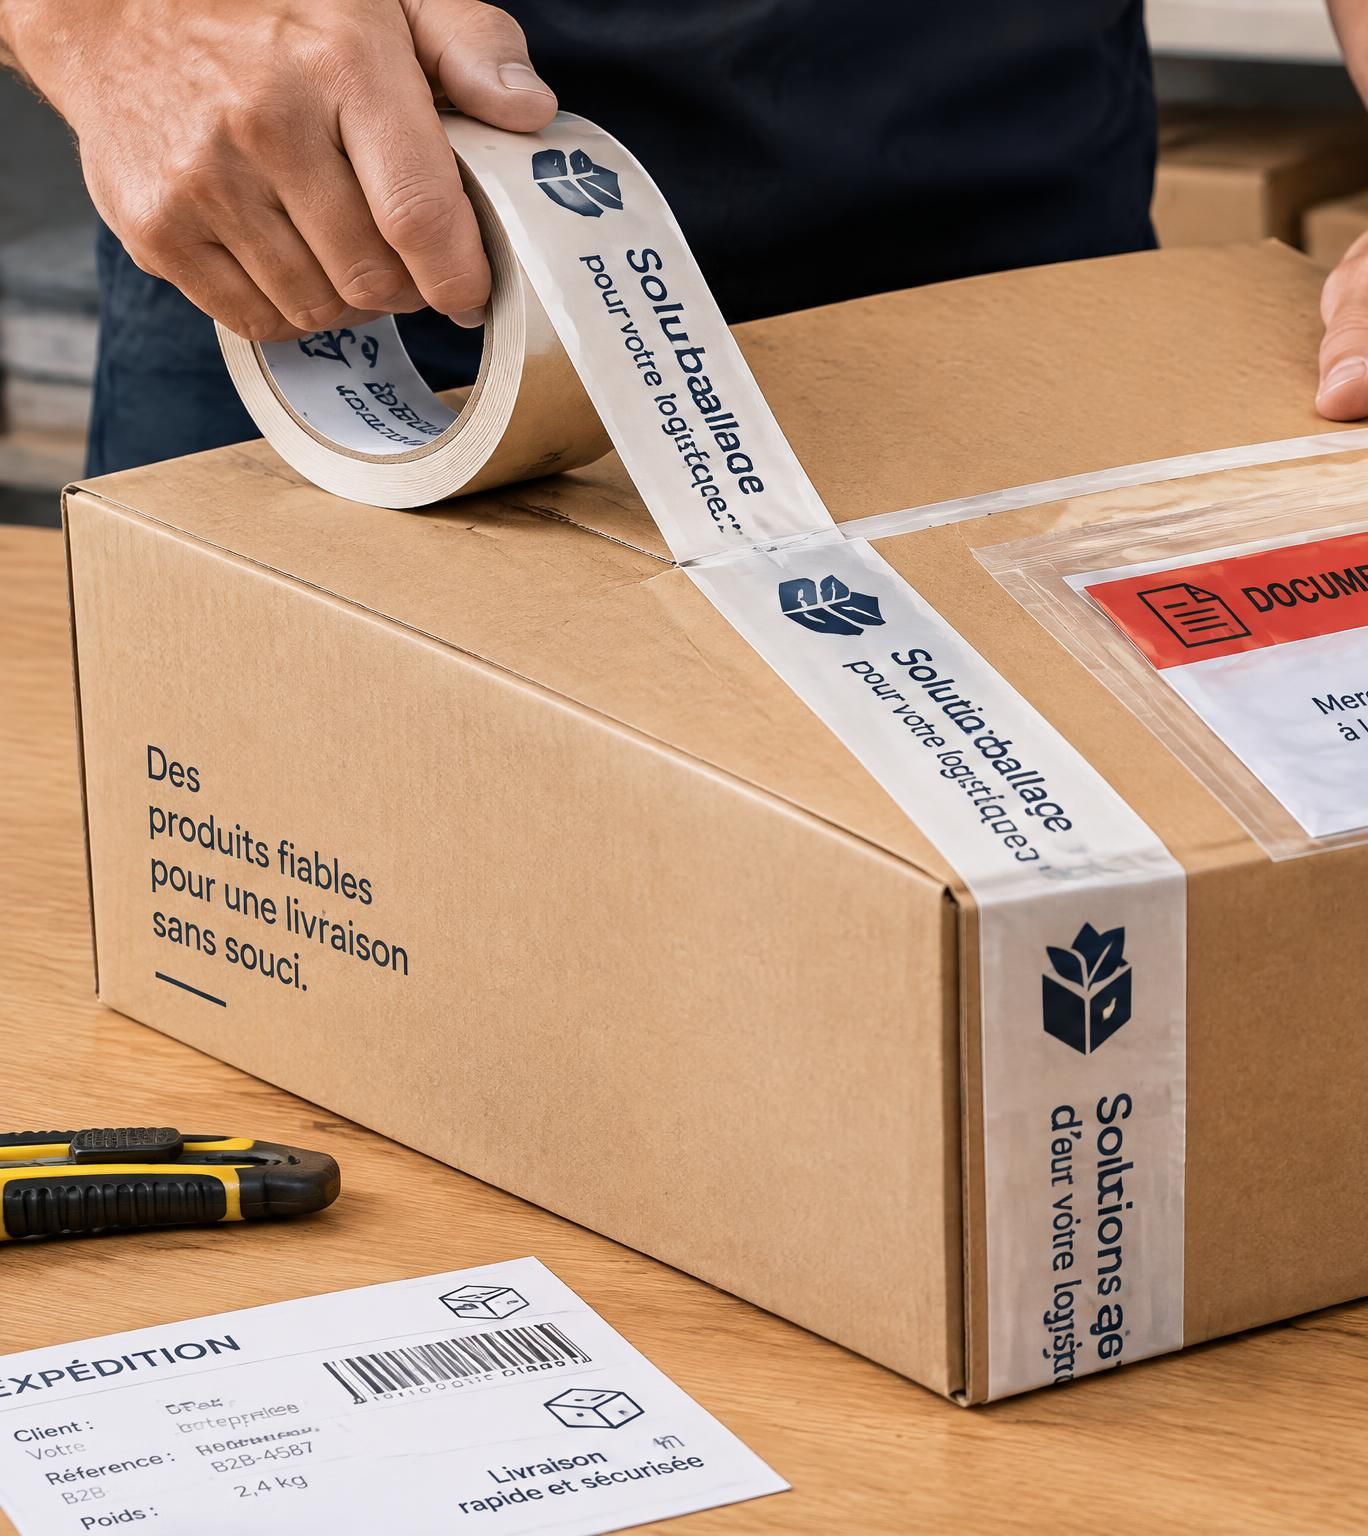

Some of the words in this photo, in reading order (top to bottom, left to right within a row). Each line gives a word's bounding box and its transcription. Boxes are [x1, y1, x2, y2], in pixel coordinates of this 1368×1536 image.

[579, 254, 631, 319] pour
[620, 321, 663, 387] votre
[842, 660, 906, 701] pour
[1337, 722, 1361, 742] à
[147, 744, 201, 793] Des
[149, 805, 270, 868] produits
[277, 839, 372, 905] fiables
[151, 858, 215, 902] pour
[224, 883, 277, 925] une
[286, 895, 408, 976] livraison
[152, 911, 216, 956] sans
[225, 936, 308, 991] souci.
[13, 1421, 82, 1443] Client
[26, 1441, 87, 1461] Votre
[234, 1480, 272, 1499] 2,4
[275, 1473, 308, 1490] kg
[458, 1486, 544, 1514] rapide
[547, 1479, 579, 1496] et
[581, 1454, 704, 1489] sécurisée
[487, 1451, 608, 1484] Livraison
[80, 1506, 147, 1531] Poids
